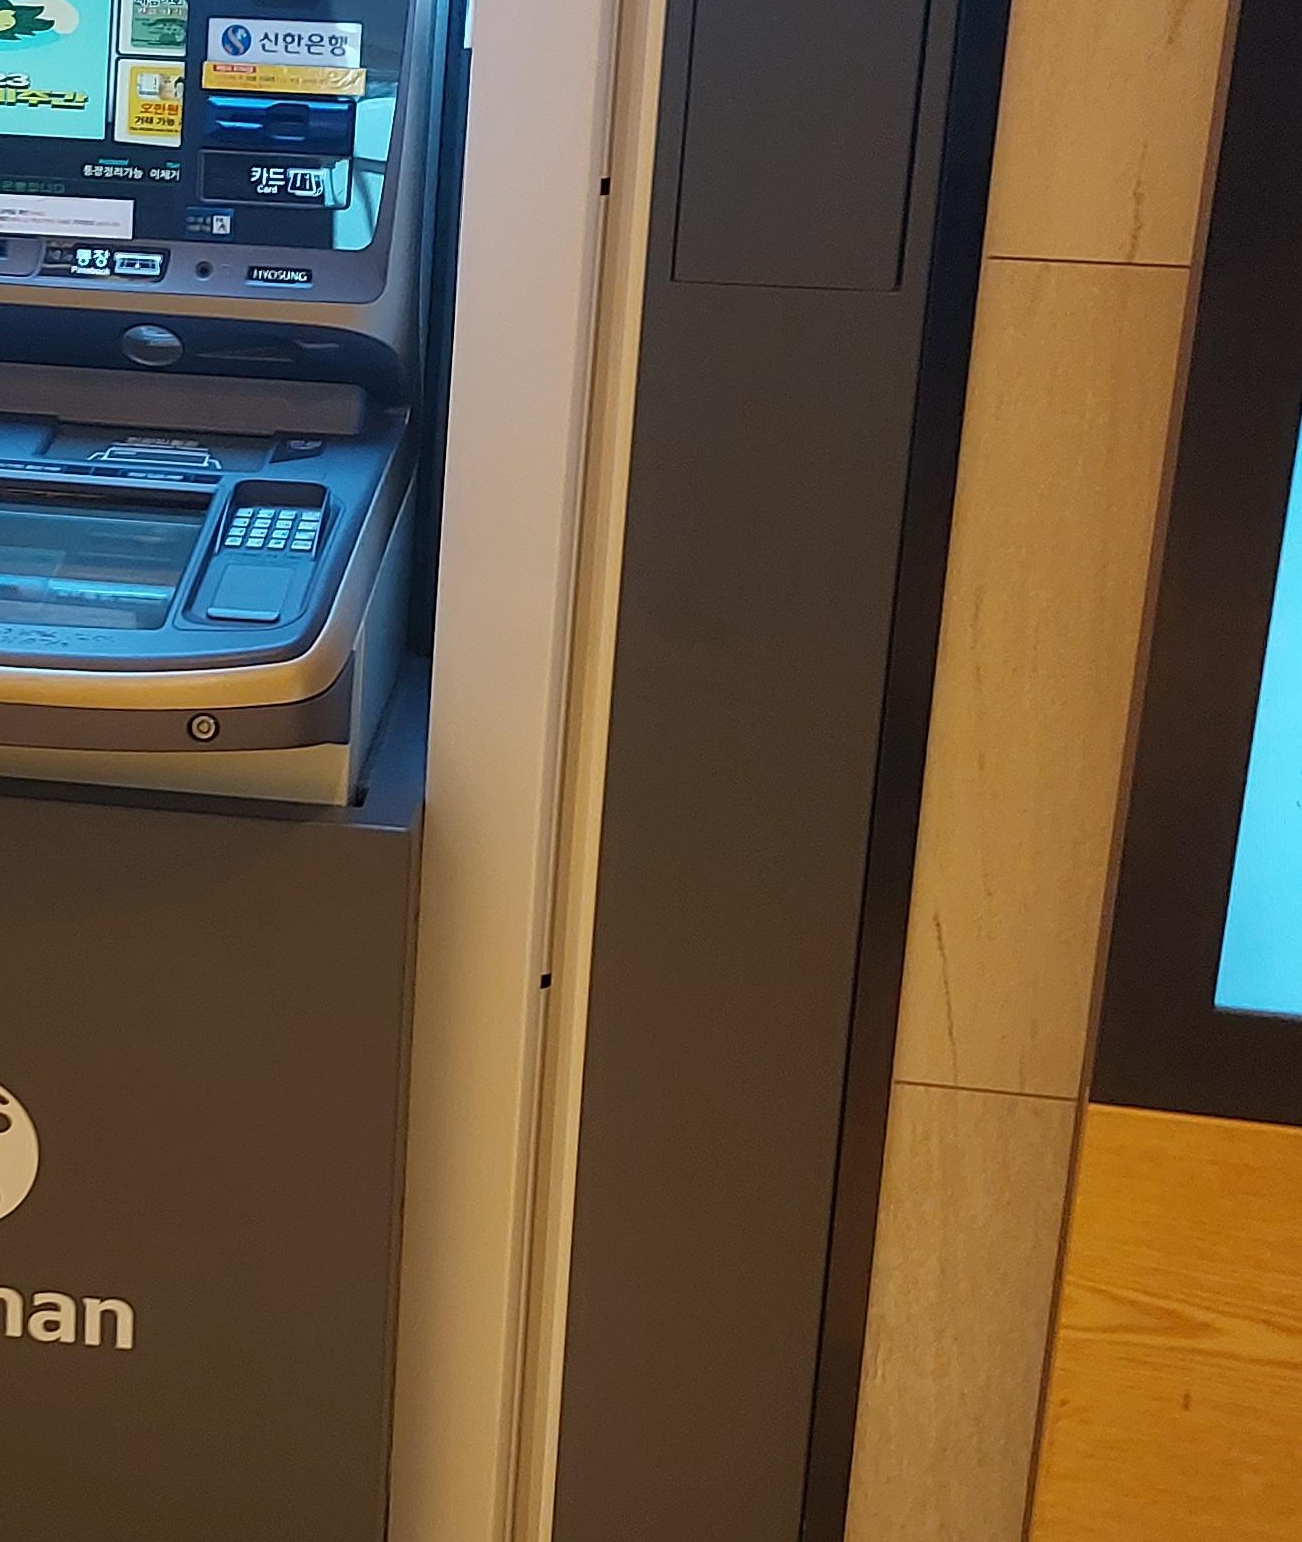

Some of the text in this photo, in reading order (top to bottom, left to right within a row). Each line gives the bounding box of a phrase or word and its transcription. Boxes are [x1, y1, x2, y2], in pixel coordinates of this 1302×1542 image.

[259, 31, 349, 58] 신한은행
[250, 165, 287, 186] 카드
[256, 184, 279, 194] Card
[76, 248, 111, 268] 통장
[252, 266, 309, 282] HYOSUNG
